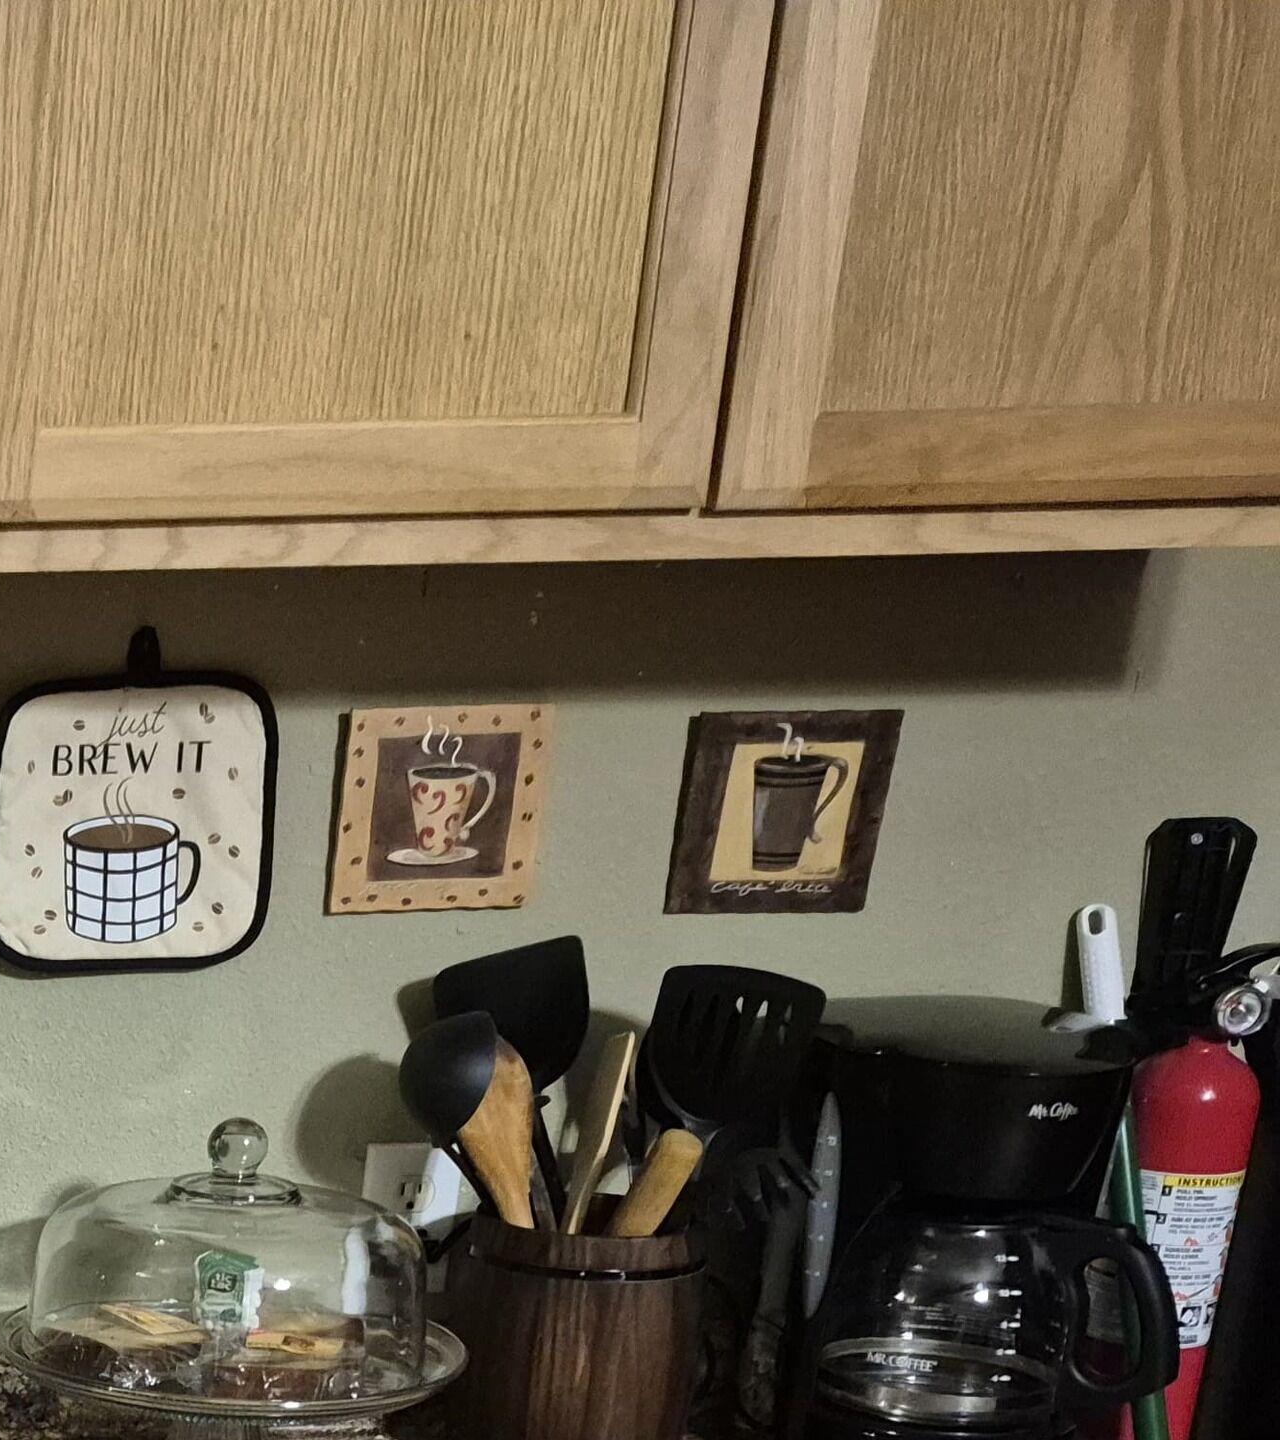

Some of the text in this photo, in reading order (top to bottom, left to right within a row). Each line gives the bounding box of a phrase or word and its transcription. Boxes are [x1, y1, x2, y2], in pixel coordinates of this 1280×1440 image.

[95, 701, 167, 758] just
[51, 740, 213, 777] BREW IT
